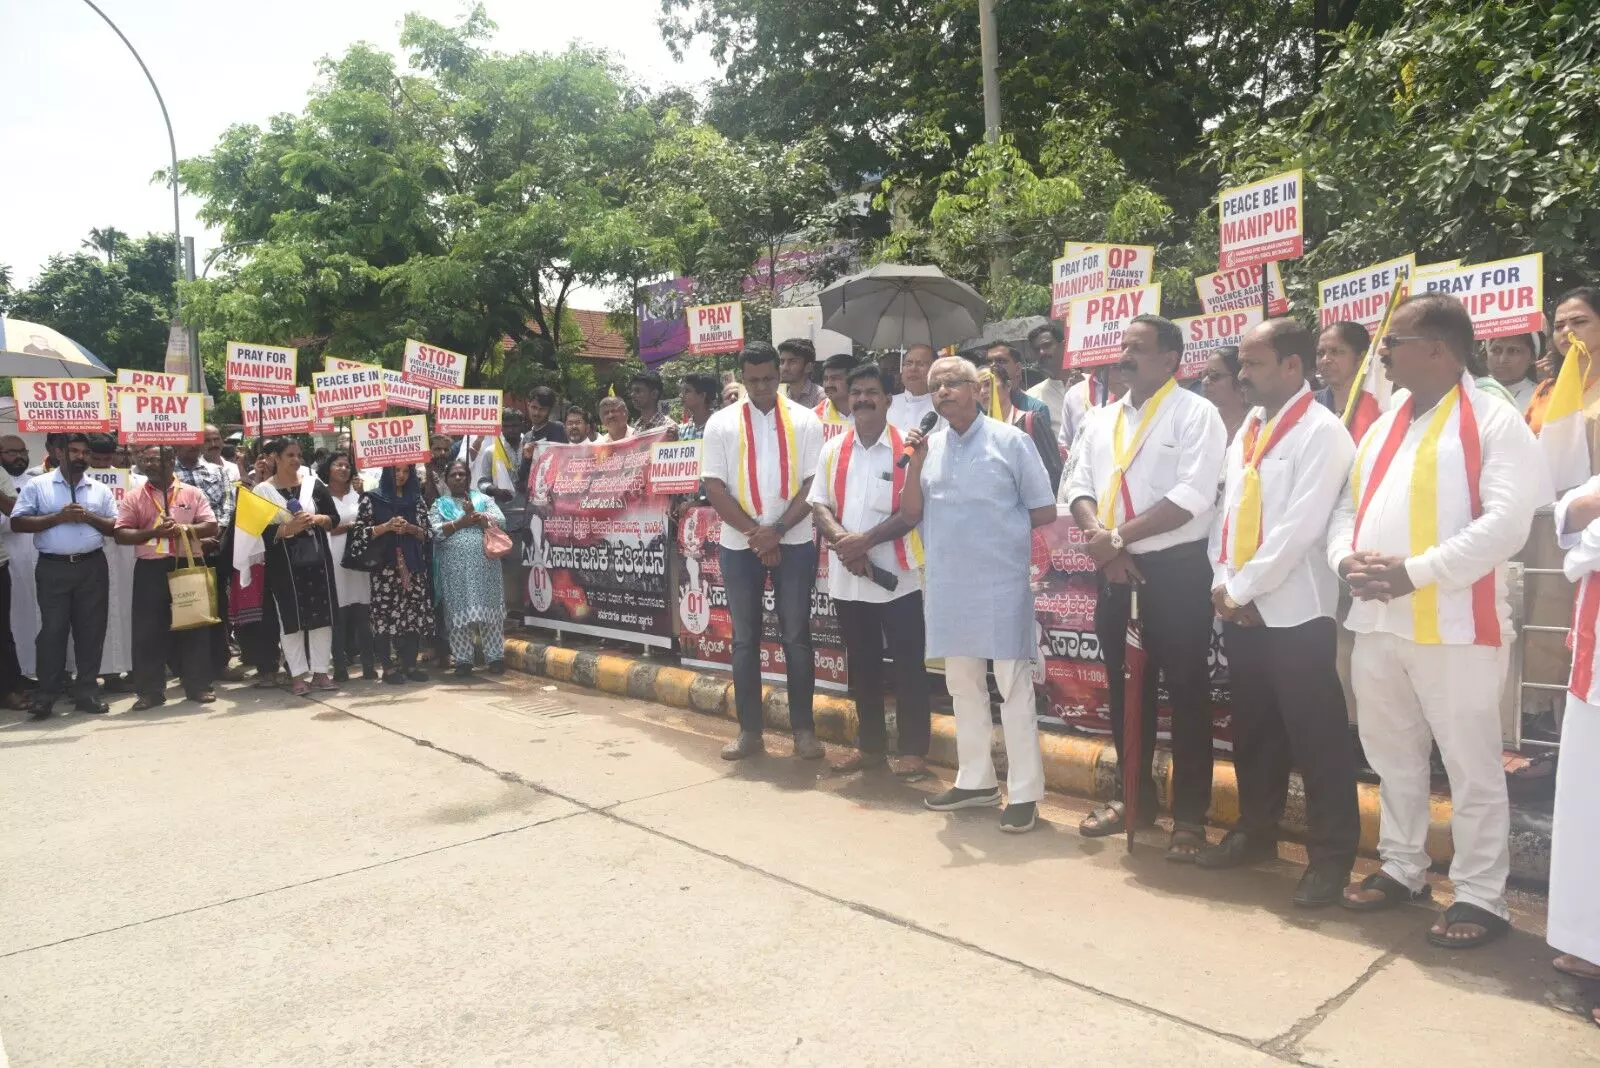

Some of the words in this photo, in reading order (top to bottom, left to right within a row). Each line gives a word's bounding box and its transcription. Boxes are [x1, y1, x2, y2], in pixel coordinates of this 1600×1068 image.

[1223, 192, 1259, 218] PEACE
[1263, 185, 1279, 206] BE
[1283, 180, 1297, 201] IN
[1223, 206, 1298, 245] MANIPUR
[1060, 260, 1080, 278] PRAY
[1082, 254, 1099, 270] FOR
[1111, 269, 1144, 278] AGAINST
[1054, 271, 1104, 300] MANIPUR
[1212, 264, 1263, 296] STOP
[1323, 278, 1367, 304] PEACE
[1371, 270, 1390, 290] BE
[1426, 274, 1475, 295] PRAY
[1481, 266, 1520, 288] FOR
[1086, 290, 1144, 325] PRAY
[1207, 290, 1243, 306] VIOLENCE
[698, 305, 732, 327] PRAY
[1103, 320, 1119, 332] FOR
[1189, 312, 1248, 342] STOP
[699, 331, 733, 343] MANIPUR
[1082, 331, 1124, 349] MANIP
[237, 348, 263, 361] PRAY
[266, 351, 286, 363] FOR
[409, 357, 437, 370] VIOLENCE
[417, 345, 457, 368] STOP
[230, 361, 293, 381] MANIPUR
[317, 373, 347, 388] PEACE
[352, 371, 366, 383] BE
[369, 370, 379, 381] IN
[410, 364, 458, 386] CHRISTIANS
[33, 381, 91, 402] STOP
[319, 383, 382, 404] MANIPUR
[439, 394, 470, 405] PEACE
[473, 394, 486, 405] BE
[488, 395, 499, 405] IN
[24, 401, 65, 409] VIOLENCE
[66, 401, 100, 409] AGAINST
[28, 409, 99, 420] CHRISTIANS
[136, 396, 189, 414] PRAY
[246, 405, 309, 423] MANIPUR
[439, 407, 498, 421] MANIPUR
[136, 421, 188, 432] MANIPUR
[367, 419, 414, 439] STOP
[360, 438, 393, 447] VIOLENCE
[394, 435, 421, 445] AGAINST
[363, 442, 421, 457] CHRISTIANS
[658, 448, 679, 460] PRAY
[680, 446, 695, 459] FOR
[652, 460, 698, 477] MANIPUR
[552, 545, 608, 571] ಸಾರ್ವಜನಿಕ
[614, 539, 665, 582] ಪ್ರತಿಭಟನೆ
[534, 566, 546, 590] 01
[688, 592, 703, 614] 01
